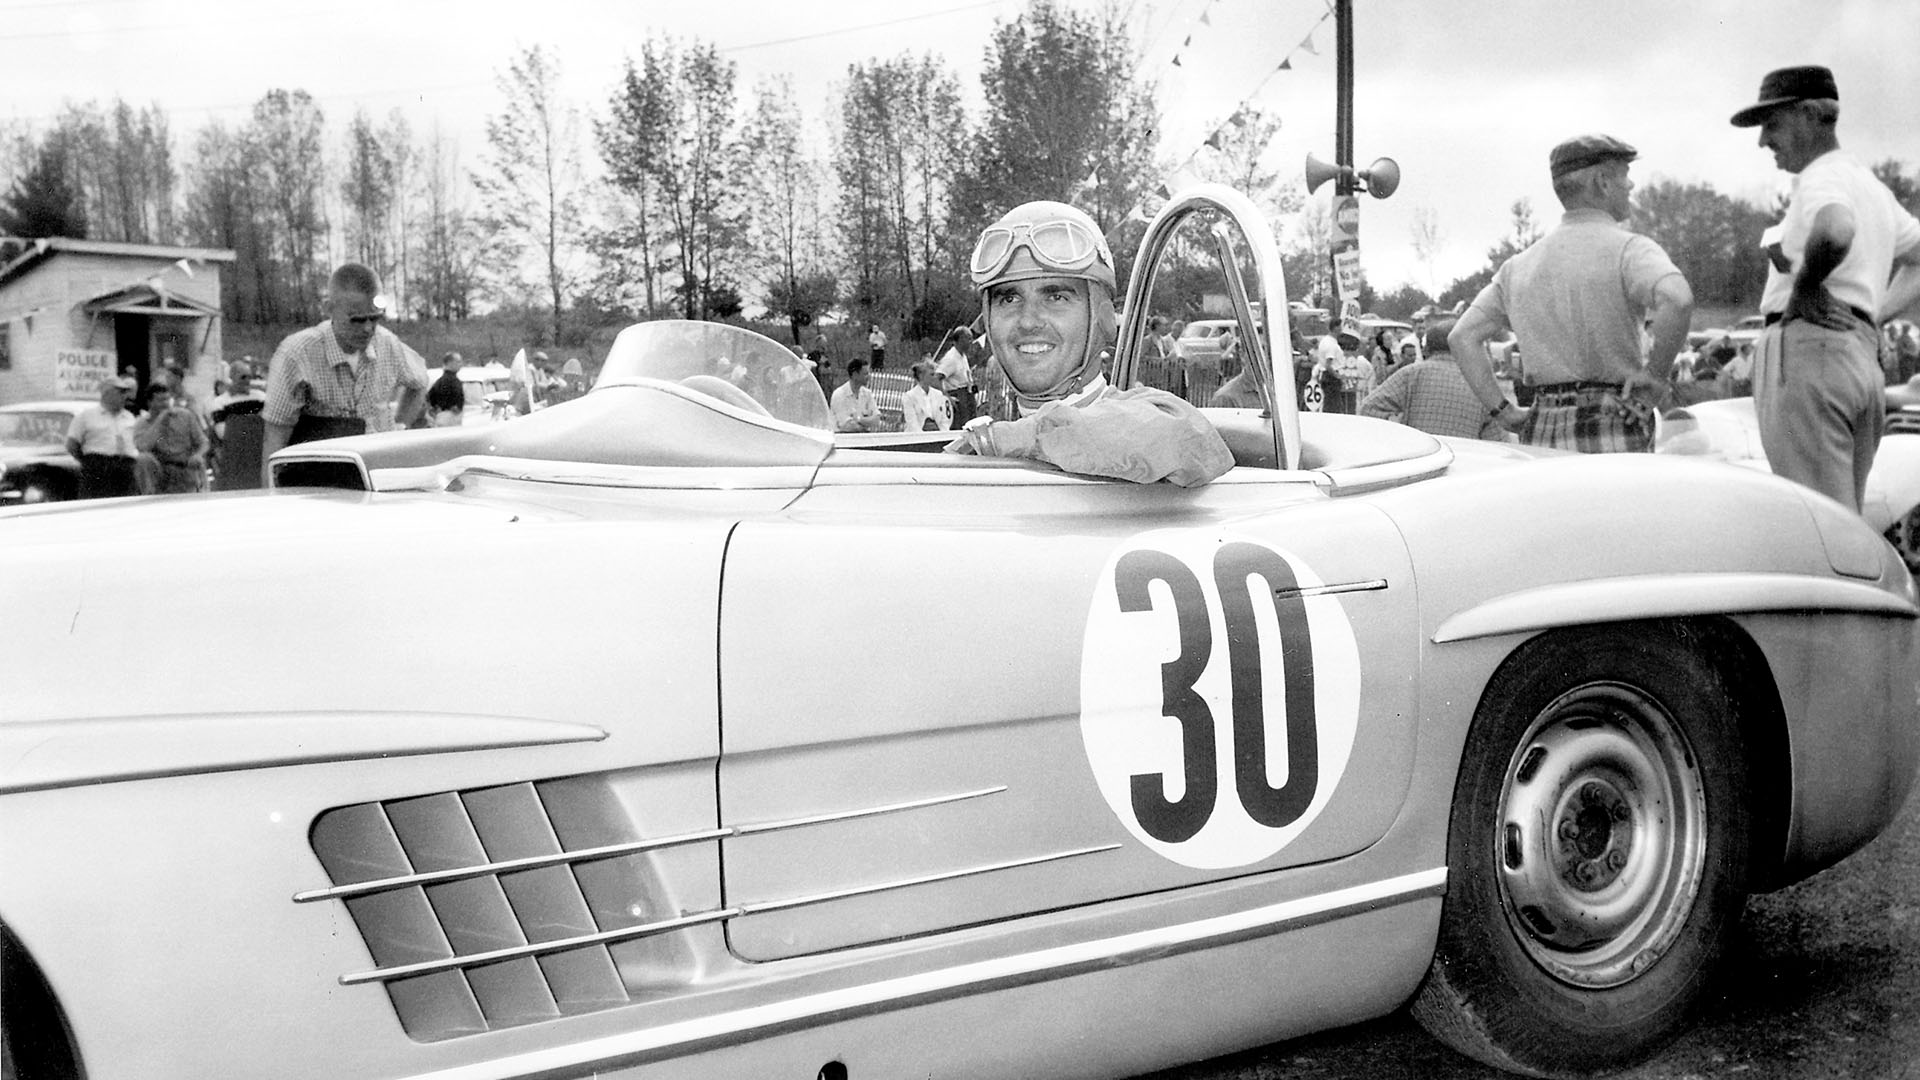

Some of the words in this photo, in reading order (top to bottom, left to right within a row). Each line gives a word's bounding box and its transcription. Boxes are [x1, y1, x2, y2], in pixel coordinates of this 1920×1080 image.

[58, 352, 108, 368] POLICE
[1306, 384, 1322, 403] 26
[1114, 541, 1319, 844] 30
